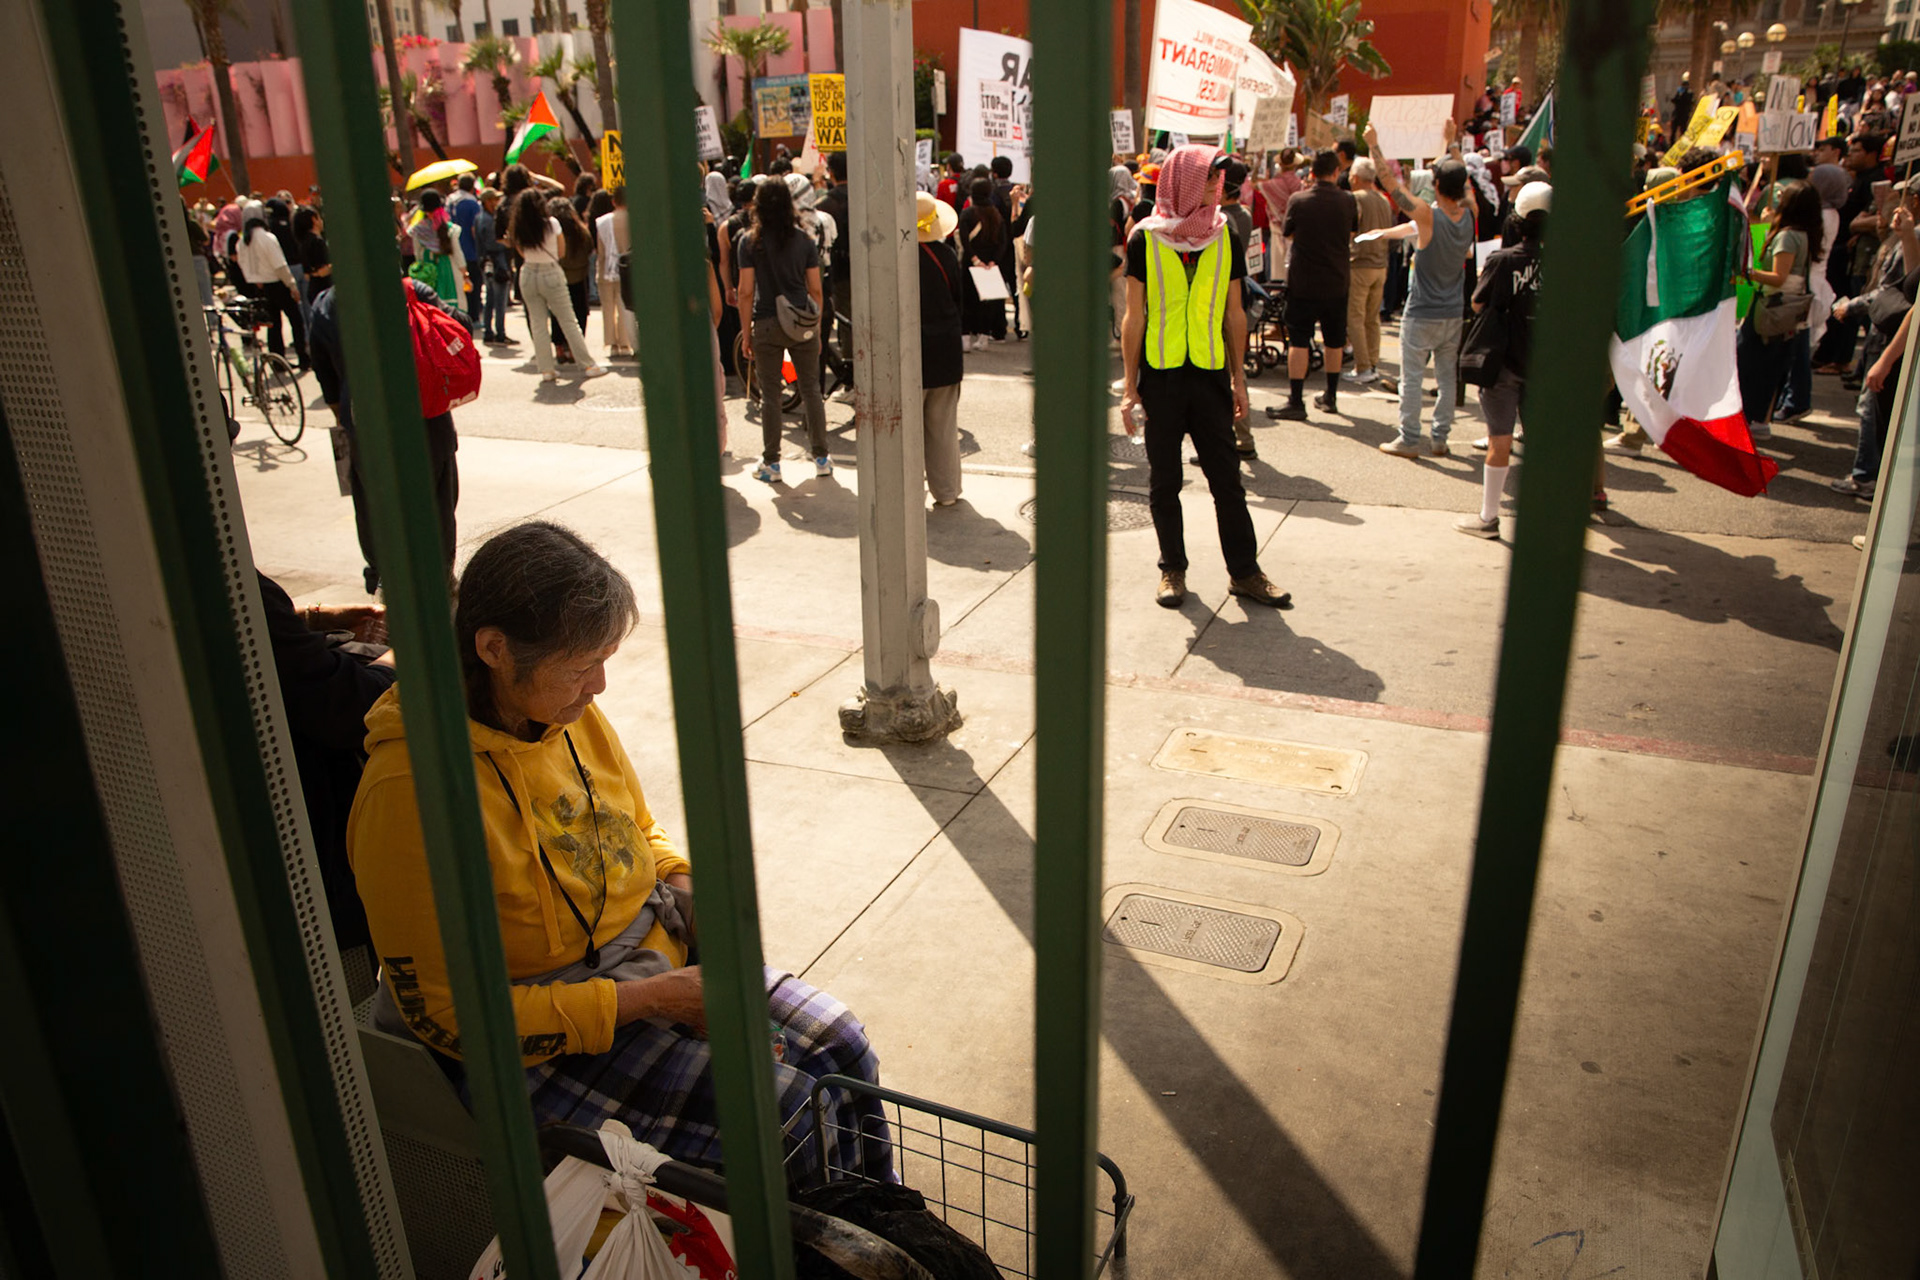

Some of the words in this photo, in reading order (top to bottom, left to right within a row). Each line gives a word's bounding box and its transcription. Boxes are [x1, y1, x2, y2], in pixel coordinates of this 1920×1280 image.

[814, 91, 831, 101] YOU
[815, 101, 828, 112] US
[981, 94, 1000, 110] STOP
[983, 128, 1007, 139] IRAN!
